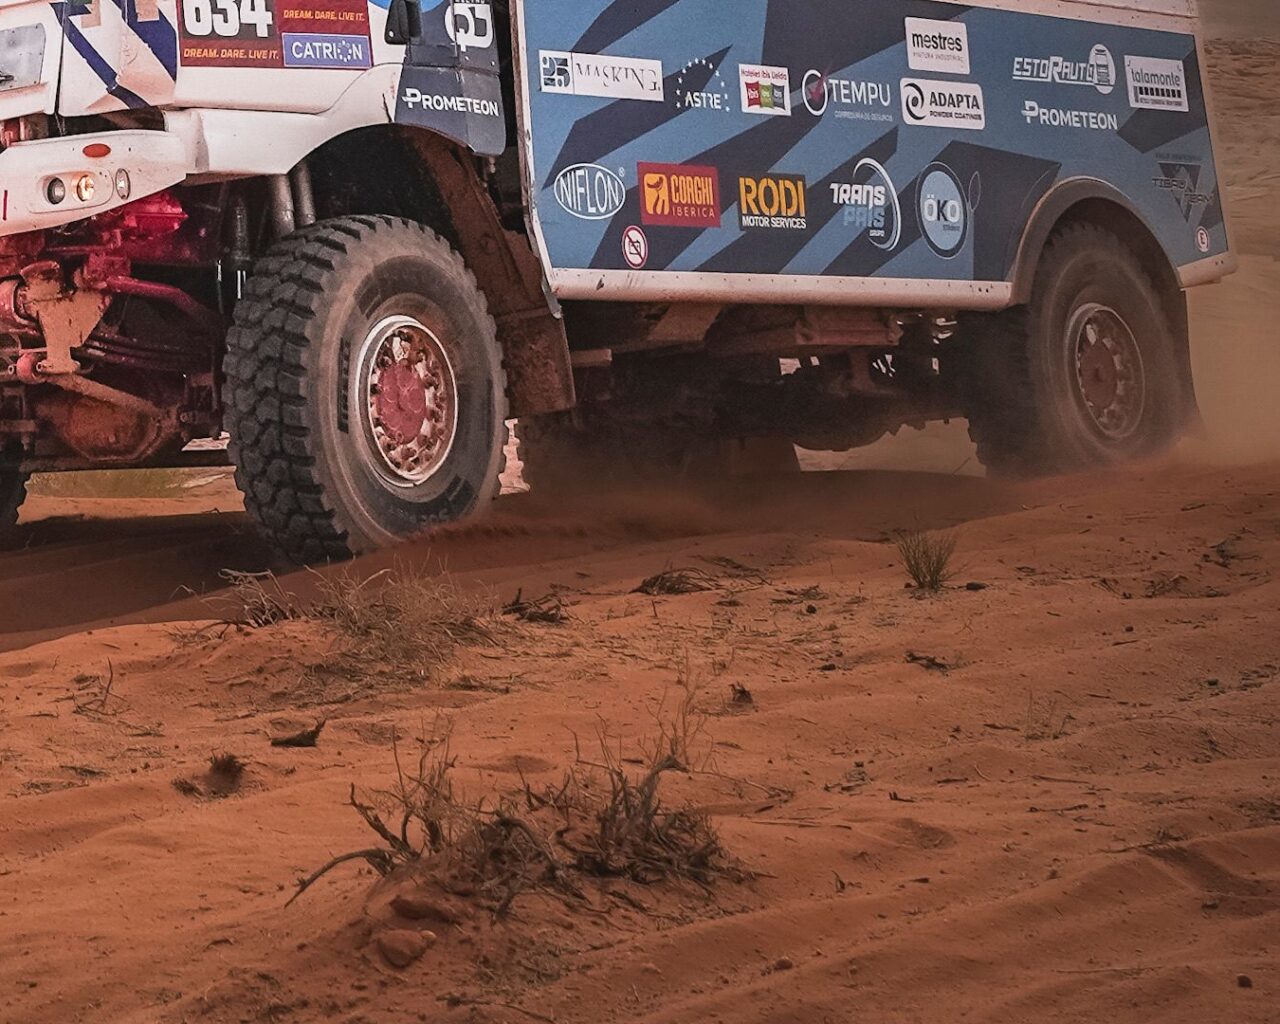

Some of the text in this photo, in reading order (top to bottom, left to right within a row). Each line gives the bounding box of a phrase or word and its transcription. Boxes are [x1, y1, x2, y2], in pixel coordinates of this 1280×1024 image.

[284, 9, 314, 19] DREAM.
[315, 10, 338, 20] DARE.
[338, 11, 354, 21] LIVE
[292, 40, 363, 62] CATRION
[912, 32, 962, 52] mestres
[183, 48, 220, 58] DREAM.
[220, 48, 247, 59] DARE.
[249, 49, 268, 59] LIVE
[1131, 68, 1181, 87] talamonte
[402, 88, 499, 116] PROMETEON
[684, 91, 721, 109] ASTRE
[829, 78, 891, 107] TEMPU
[929, 92, 980, 110] ADAPTA
[1022, 101, 1118, 130] PROMETEON
[560, 168, 620, 213] NIFLON
[671, 174, 714, 205] CORGHI
[739, 177, 806, 218] RODI
[829, 182, 886, 209] TRANS
[672, 206, 715, 218] IBERICA
[742, 215, 807, 229] MOTOR SERVICES
